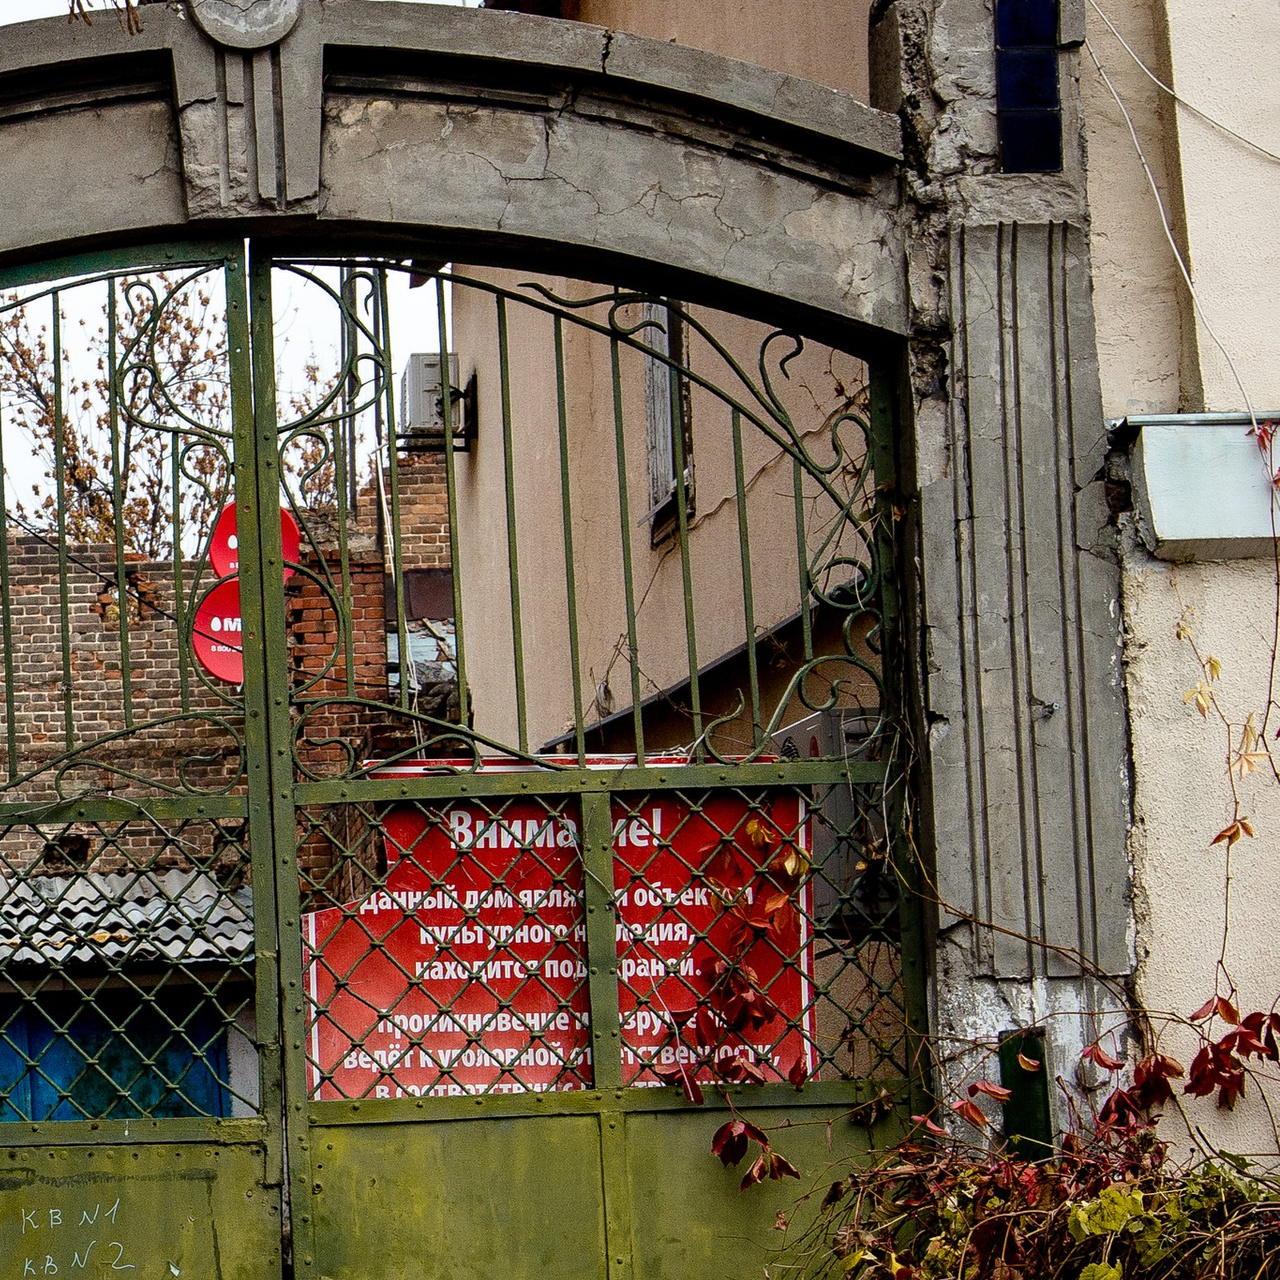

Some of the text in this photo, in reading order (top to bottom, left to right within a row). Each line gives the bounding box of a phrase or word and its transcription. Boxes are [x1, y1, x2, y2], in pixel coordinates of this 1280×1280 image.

[449, 808, 662, 849] Внимаие!
[464, 890, 513, 913] дом
[420, 923, 568, 951] культурного
[378, 1008, 569, 1039] Проникновение
[344, 1043, 414, 1073] ведёт
[420, 1050, 433, 1068] к
[438, 1041, 564, 1071] уголовной
